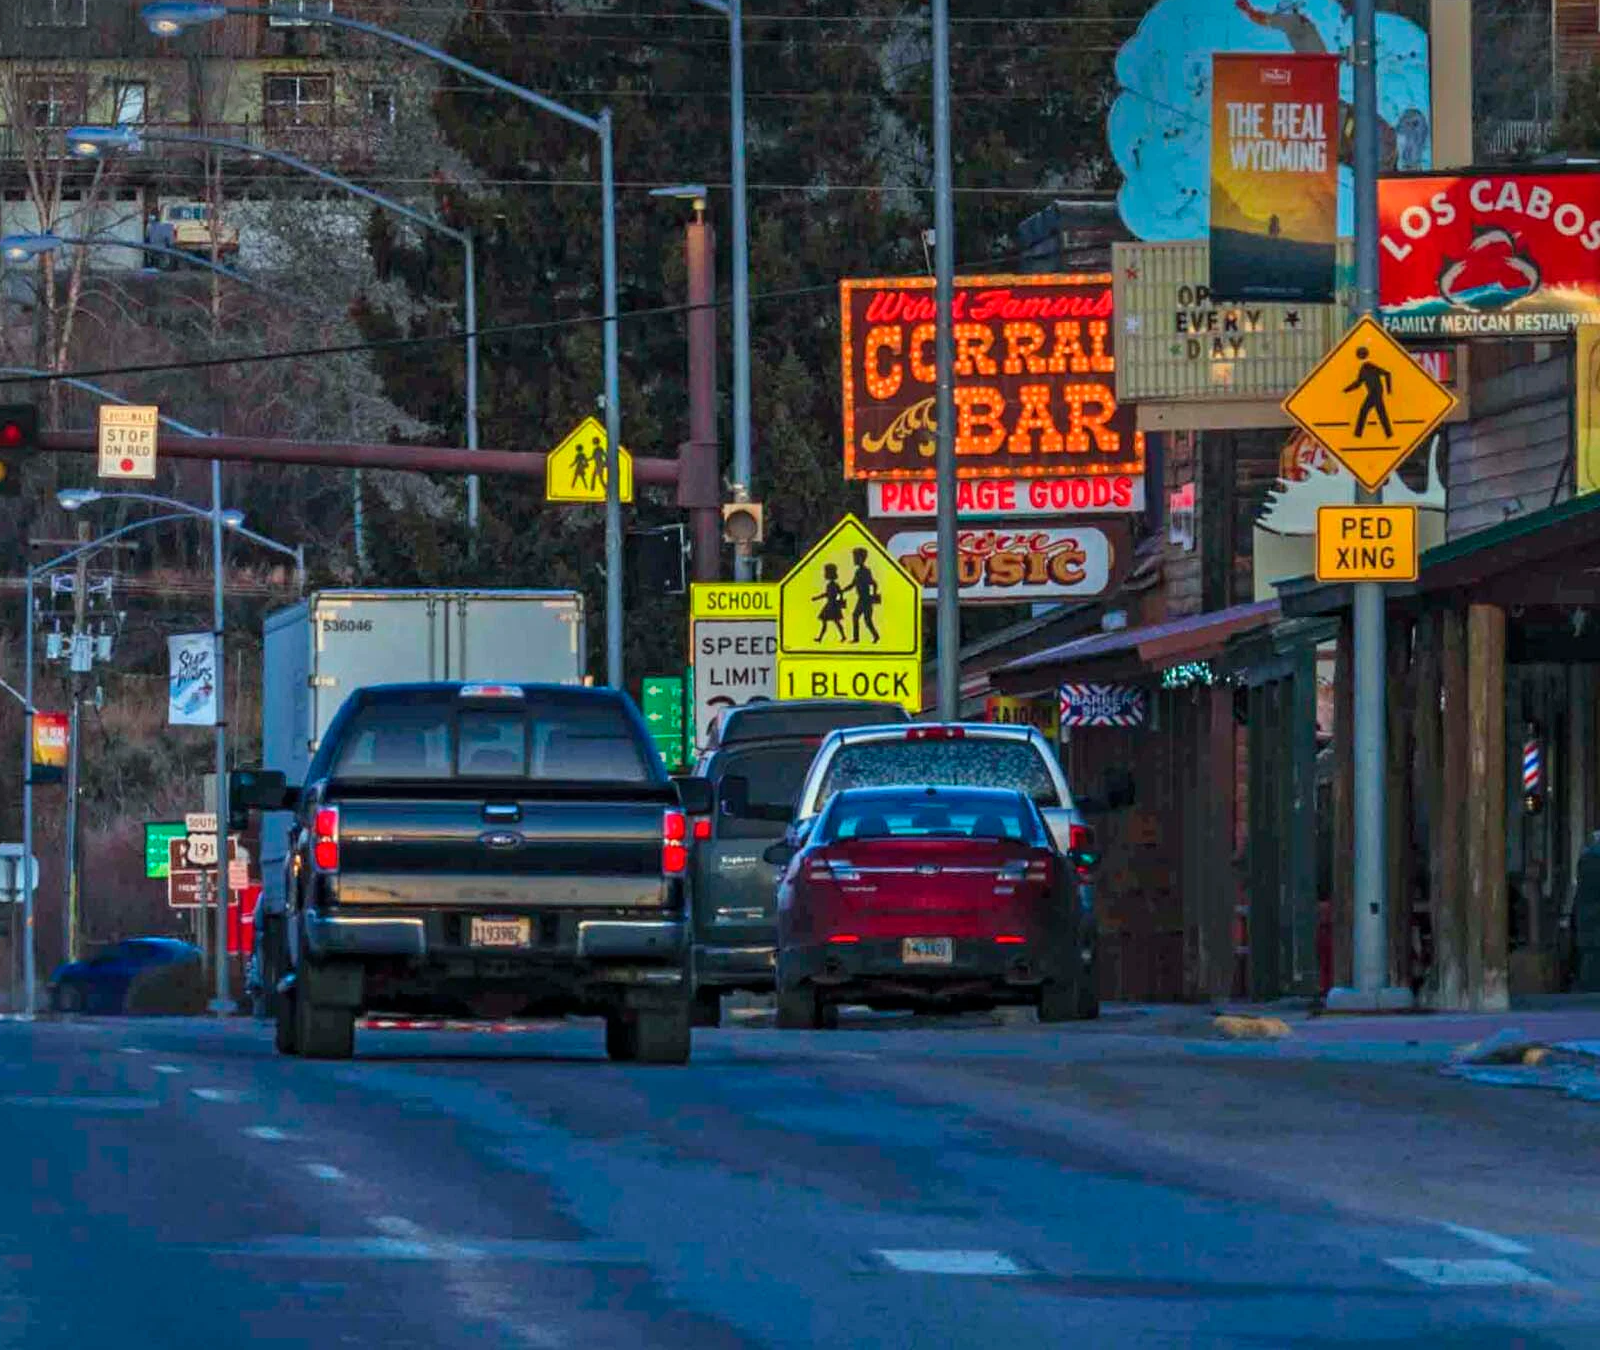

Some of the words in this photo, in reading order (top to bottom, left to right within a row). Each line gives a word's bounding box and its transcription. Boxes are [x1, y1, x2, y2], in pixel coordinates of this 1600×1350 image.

[1226, 102, 1265, 139] THE
[1272, 102, 1327, 140] REAL
[1229, 138, 1328, 173] WYOMING
[1380, 192, 1456, 262] LOS
[1469, 178, 1600, 251] CABOS
[866, 291, 969, 322] Word
[970, 289, 1113, 321] Famous
[1175, 310, 1262, 333] EVERY
[1382, 315, 1438, 333] FAMILY
[1441, 315, 1511, 333] MEXICAN
[864, 320, 1115, 400] CORRAL
[1186, 338, 1244, 360] DAY
[953, 382, 1121, 456] BAR
[107, 428, 150, 443] STOP
[105, 445, 122, 456] ON
[127, 445, 151, 457] RED
[881, 479, 1016, 514] PACAGE
[1029, 476, 1135, 510] GOODS
[1341, 517, 1393, 540] PED
[899, 549, 1088, 588] MUSIC
[1335, 546, 1396, 570] XING
[706, 591, 773, 611] SCHOOL
[322, 619, 373, 633] 536046
[701, 635, 777, 656] SPEED
[709, 666, 771, 686] LIMIT
[787, 671, 795, 696] 1
[810, 670, 911, 697] BLOCK
[1082, 705, 1122, 717] SHOP
[193, 843, 215, 857] 191
